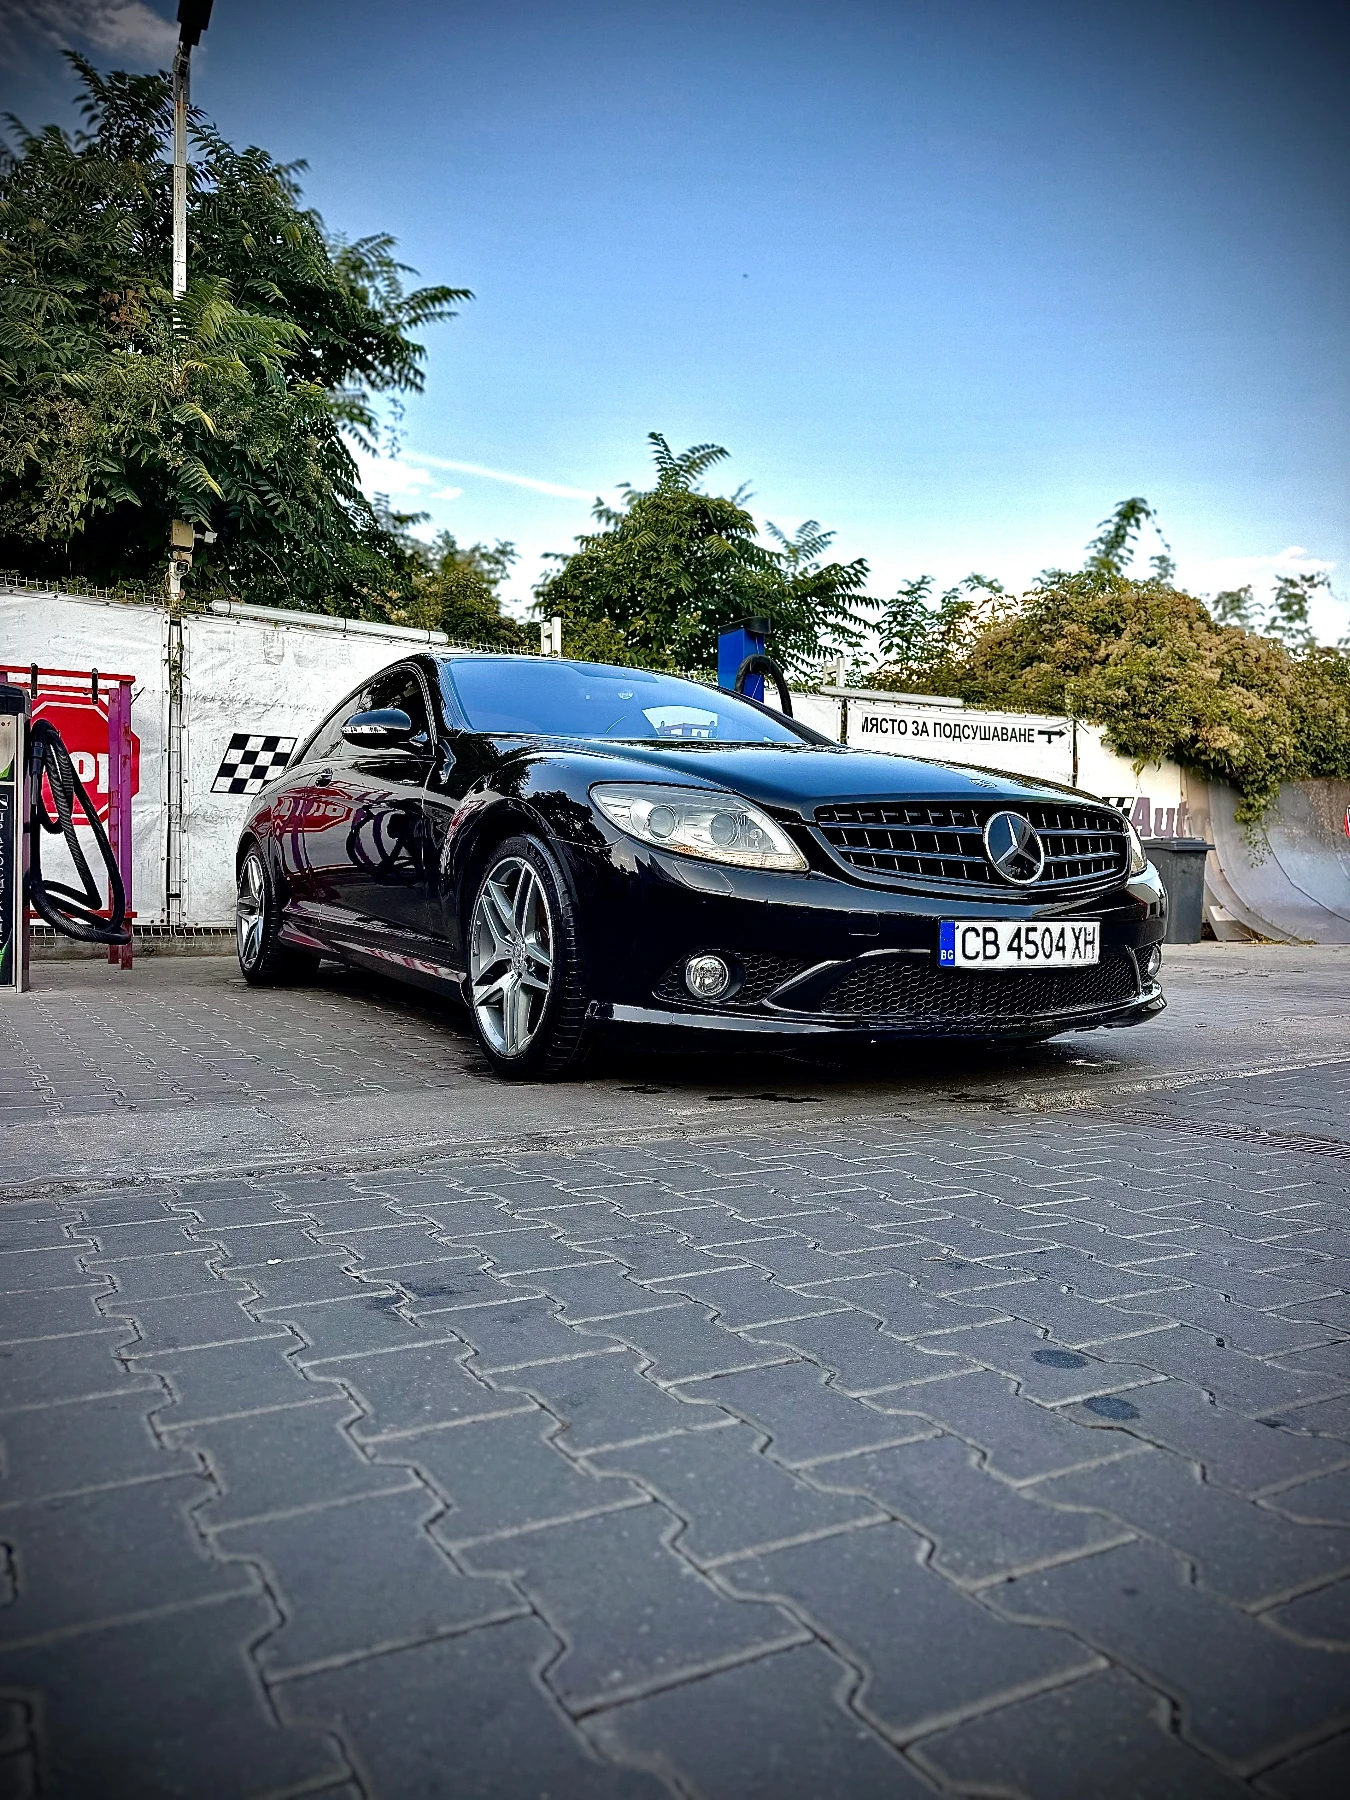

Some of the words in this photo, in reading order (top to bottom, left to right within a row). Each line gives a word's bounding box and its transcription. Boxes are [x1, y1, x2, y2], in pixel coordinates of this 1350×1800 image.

[911, 720, 929, 737] ЗА
[933, 722, 1035, 743] ПОДСУШАВАНЕ
[940, 949, 954, 960] BG
[961, 926, 1000, 960] CB
[1006, 926, 1067, 960] 4504
[1071, 926, 1096, 960] XH
